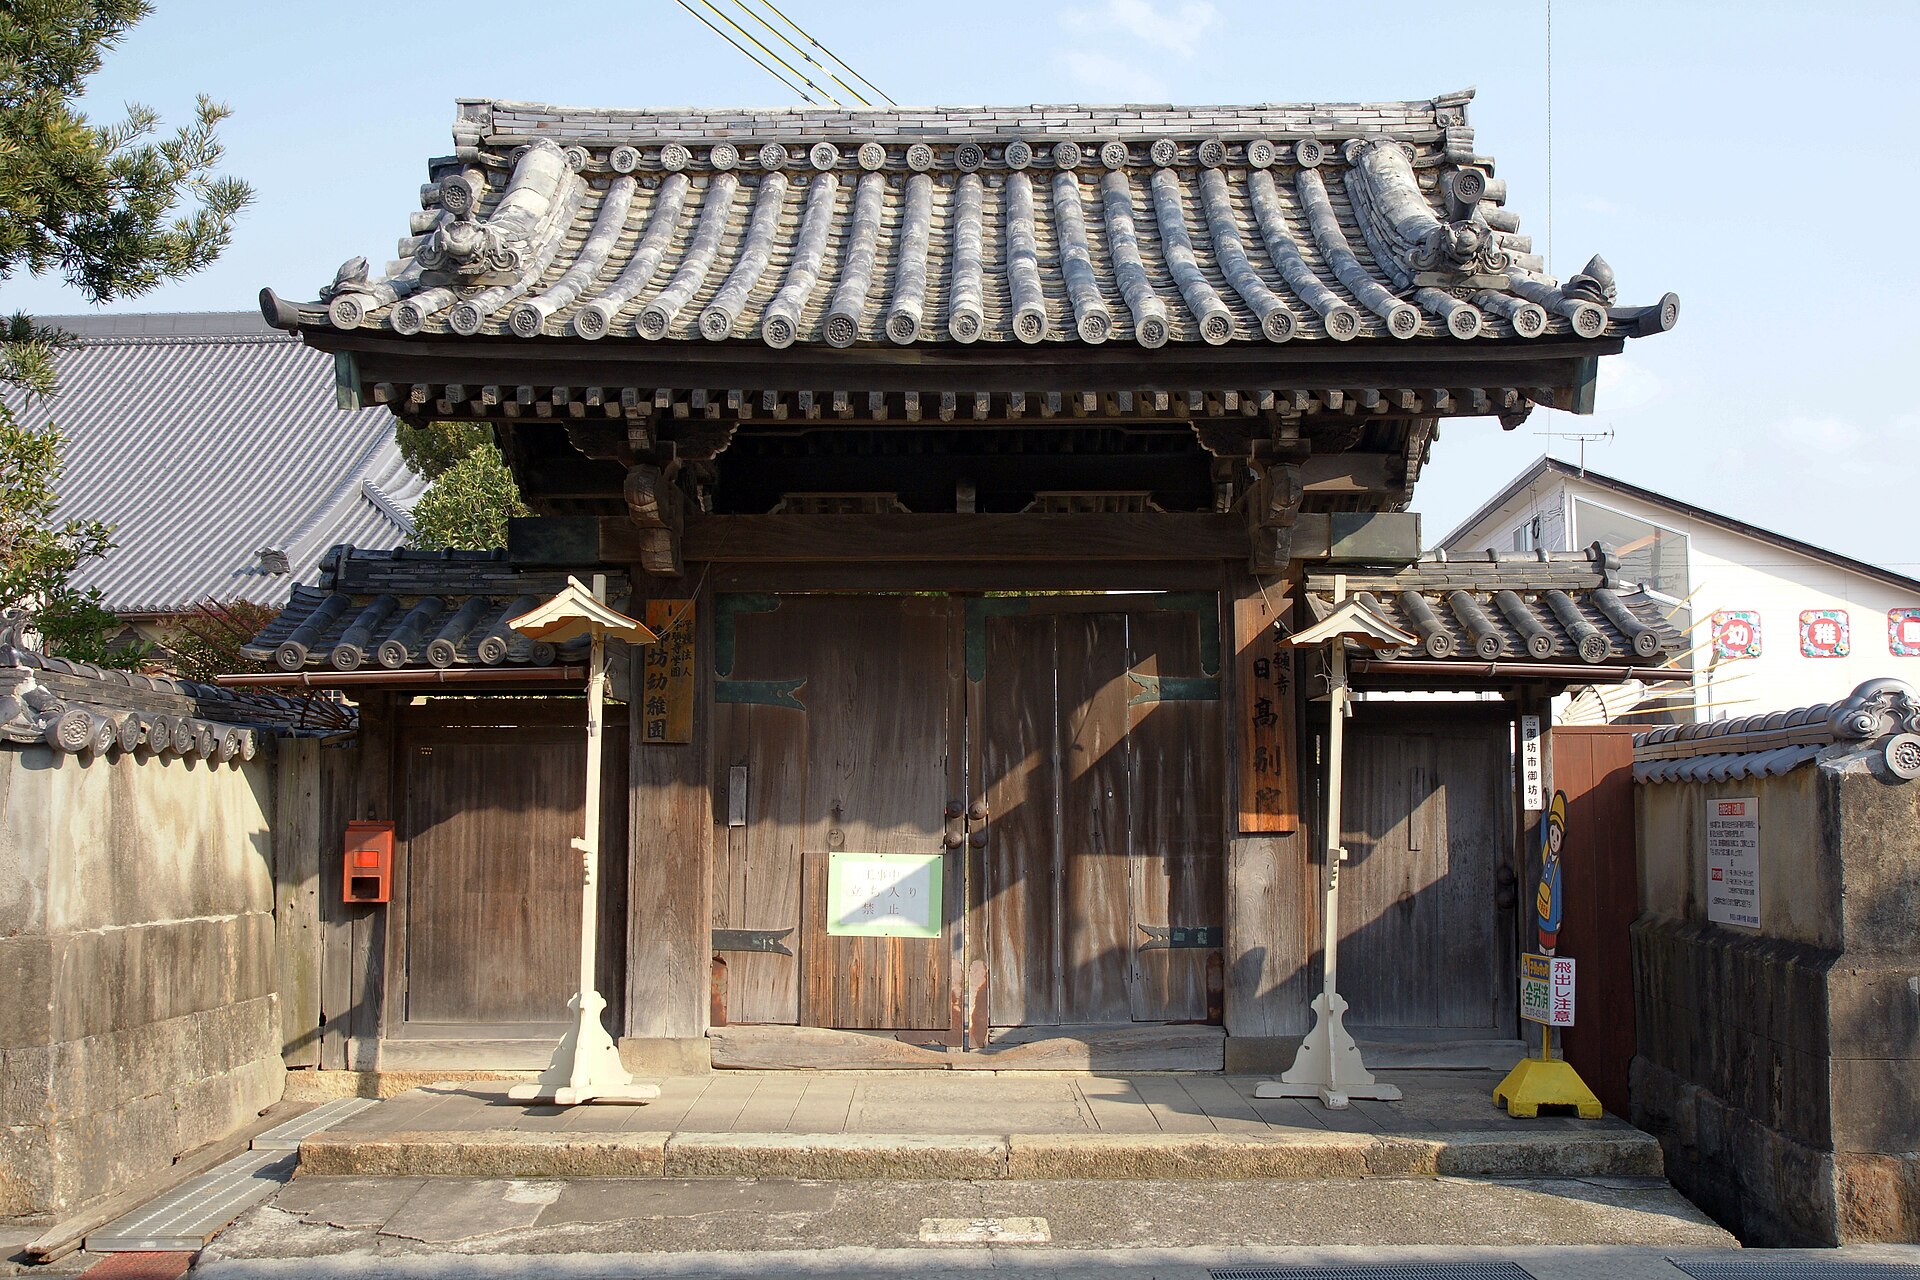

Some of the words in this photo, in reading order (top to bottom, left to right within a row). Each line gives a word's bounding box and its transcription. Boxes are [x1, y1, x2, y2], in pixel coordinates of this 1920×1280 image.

[1252, 657, 1282, 816] 日高別院
[1526, 728, 1538, 796] 御坊市御坊
[863, 902, 900, 915] 禁止
[1553, 961, 1572, 1022] 飛出し注意
